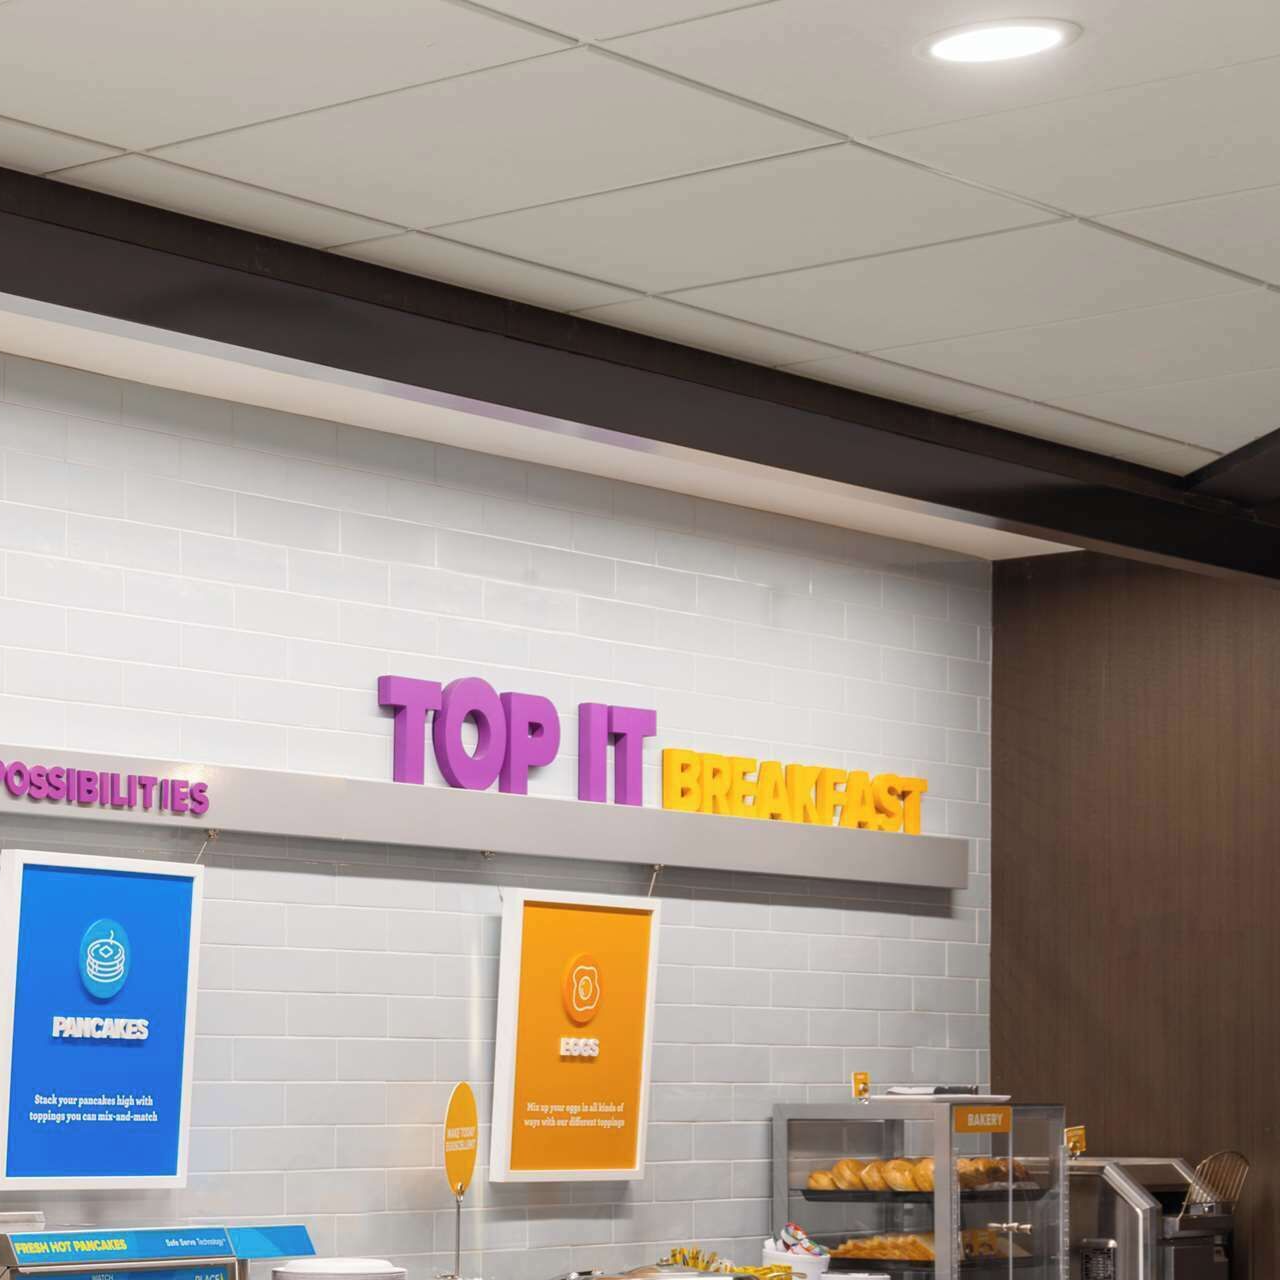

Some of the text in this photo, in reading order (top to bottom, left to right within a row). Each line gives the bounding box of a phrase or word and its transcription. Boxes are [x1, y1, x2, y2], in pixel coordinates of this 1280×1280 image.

[378, 675, 657, 807] TOP IT
[662, 748, 928, 835] BREAKFAST
[52, 1016, 149, 1041] PANCAKES
[559, 1037, 600, 1057] EGGS
[34, 1094, 153, 1108] Stack your pancakes high with
[527, 1102, 539, 1112] Mix
[549, 1103, 565, 1115] your
[565, 1103, 582, 1115] eggs
[589, 1102, 598, 1112] all
[599, 1102, 617, 1112] kinds
[617, 1102, 625, 1112] of
[29, 1110, 158, 1124] toppings you can mix-and-match
[524, 1116, 625, 1129] ways with our different toppings
[967, 1112, 1003, 1126] BAKERY
[14, 1238, 128, 1254] FRESH HOT PANCAKES
[165, 1238, 179, 1247] Safe
[180, 1238, 197, 1247] Serve
